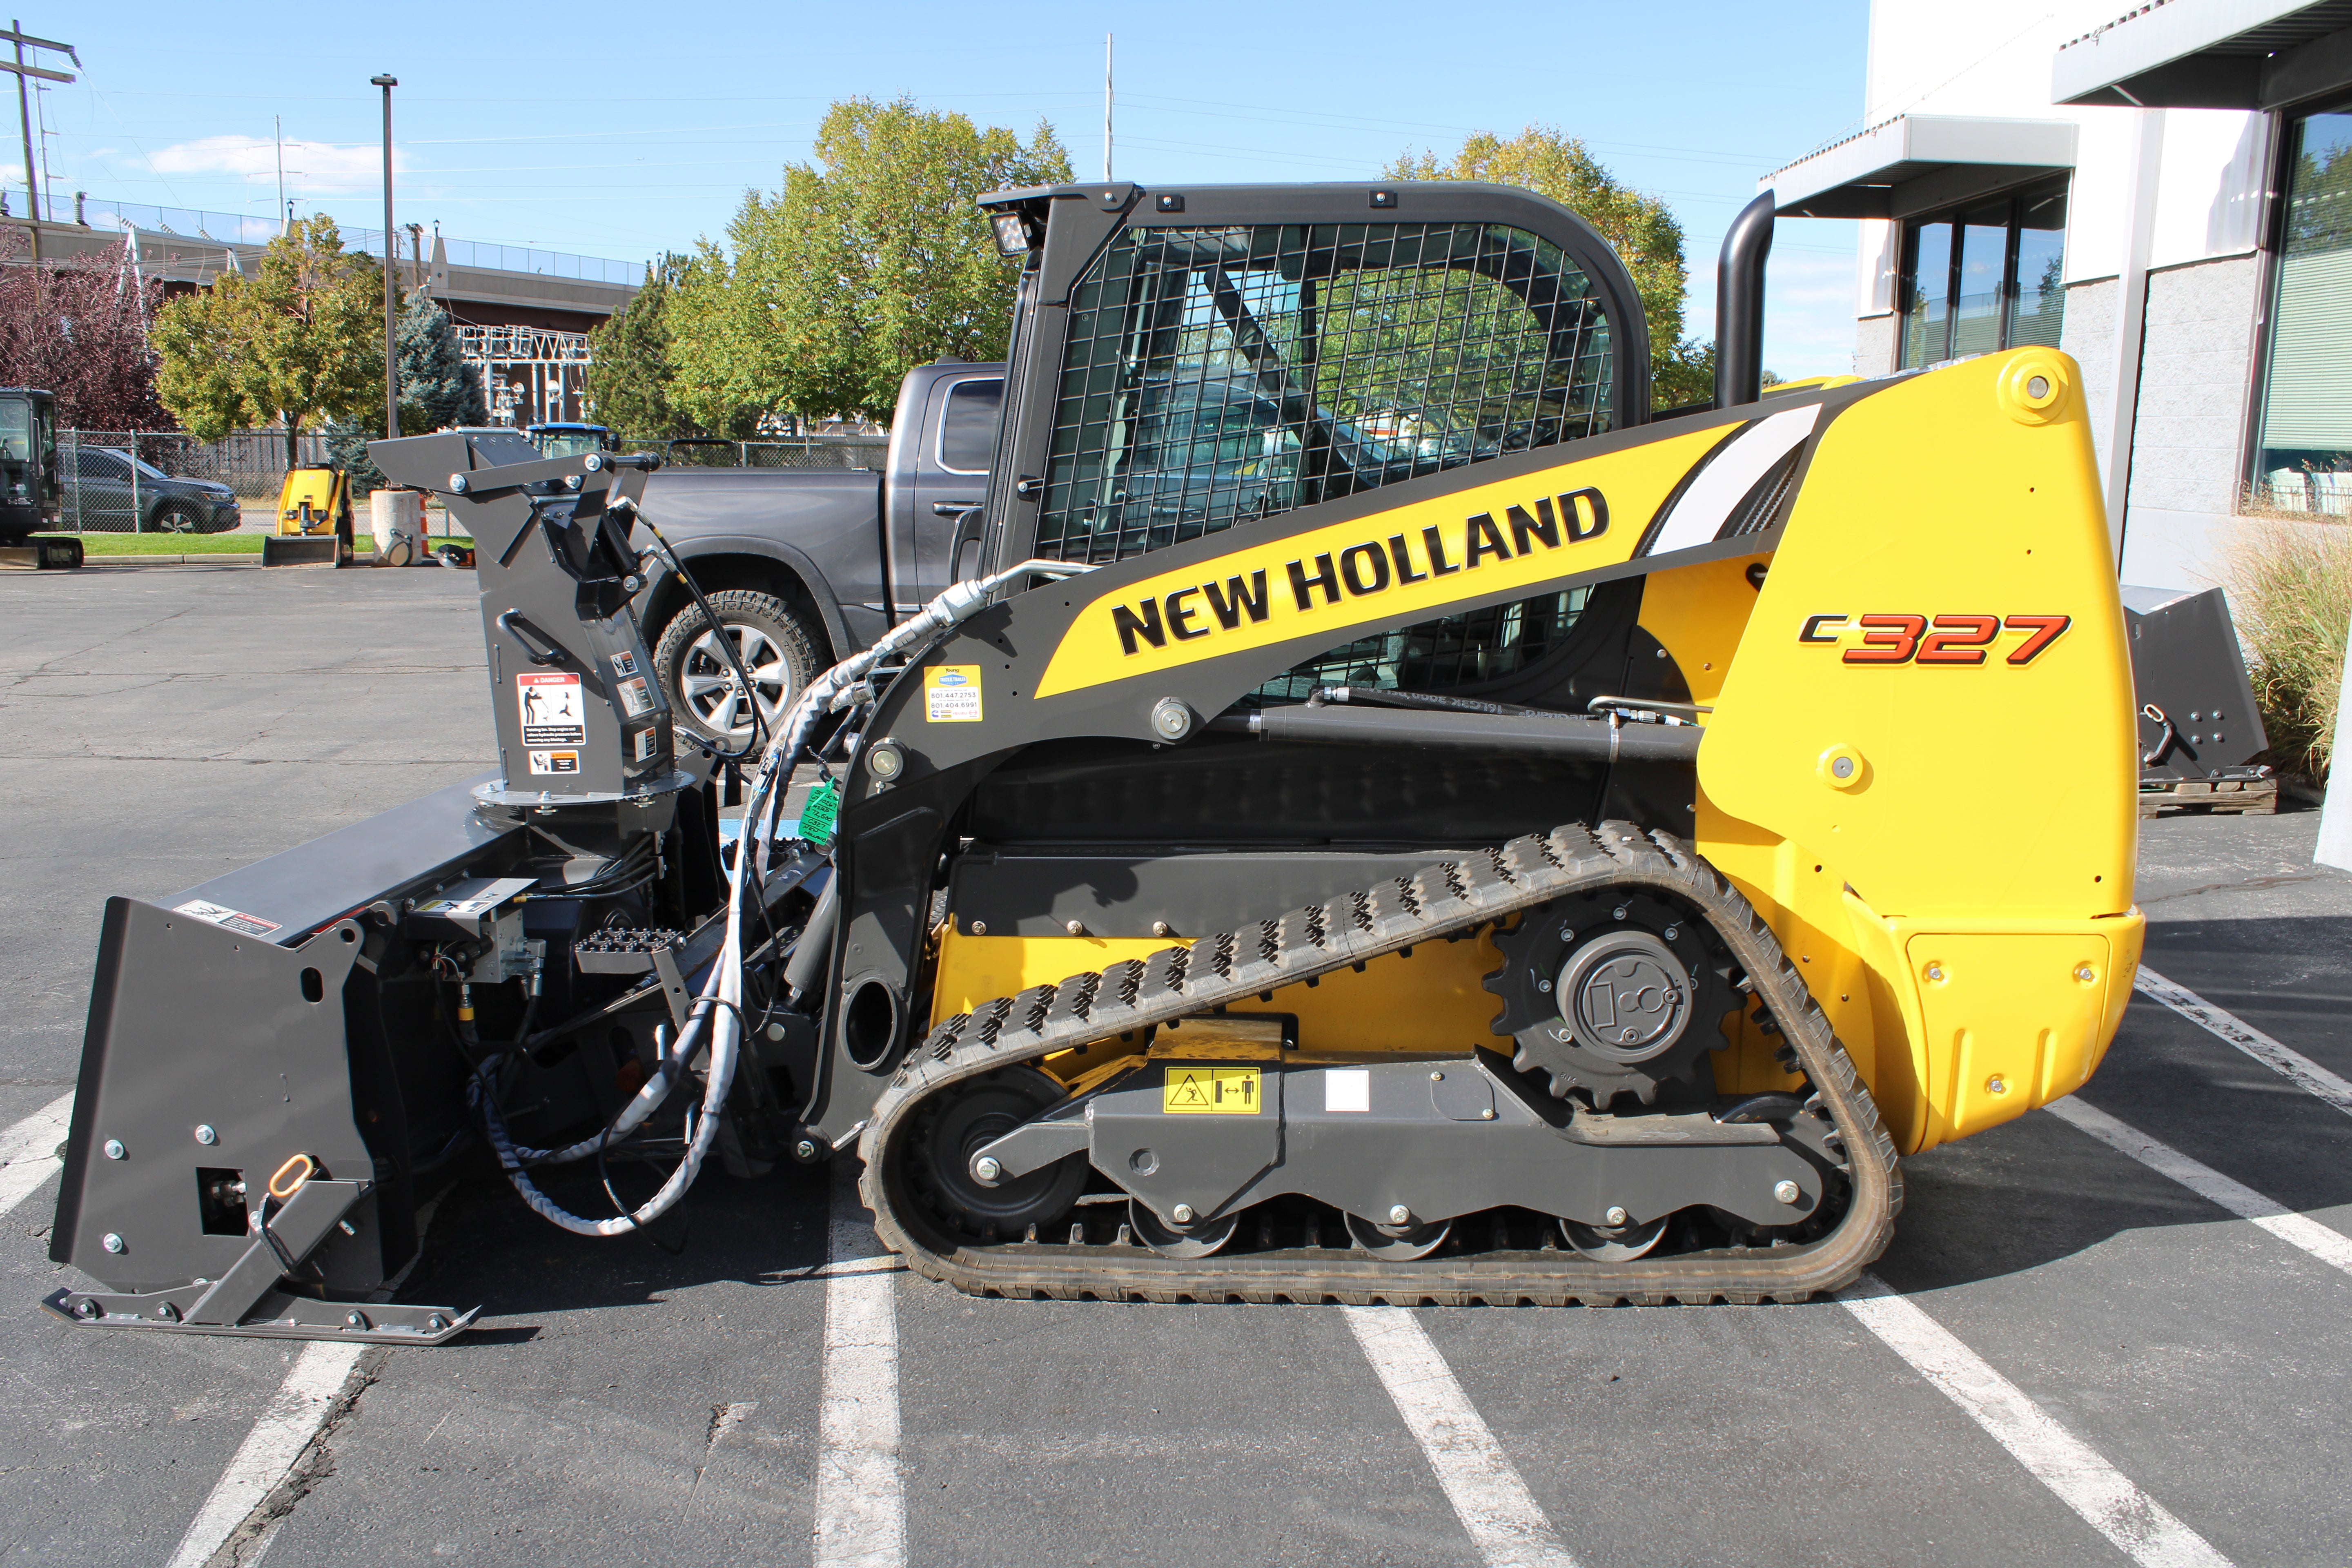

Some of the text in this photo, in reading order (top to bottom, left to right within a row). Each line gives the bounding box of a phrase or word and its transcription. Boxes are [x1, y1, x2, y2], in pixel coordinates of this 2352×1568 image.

[1111, 486, 1610, 655] NEW HOLLAND
[781, 640, 801, 688] RENEGADE
[1411, 693, 1447, 704] 3000
[1450, 697, 1502, 715] 16LG3K
[808, 819, 826, 829] C327
[803, 831, 826, 842] HOLLAND
[245, 916, 278, 928] DANGER
